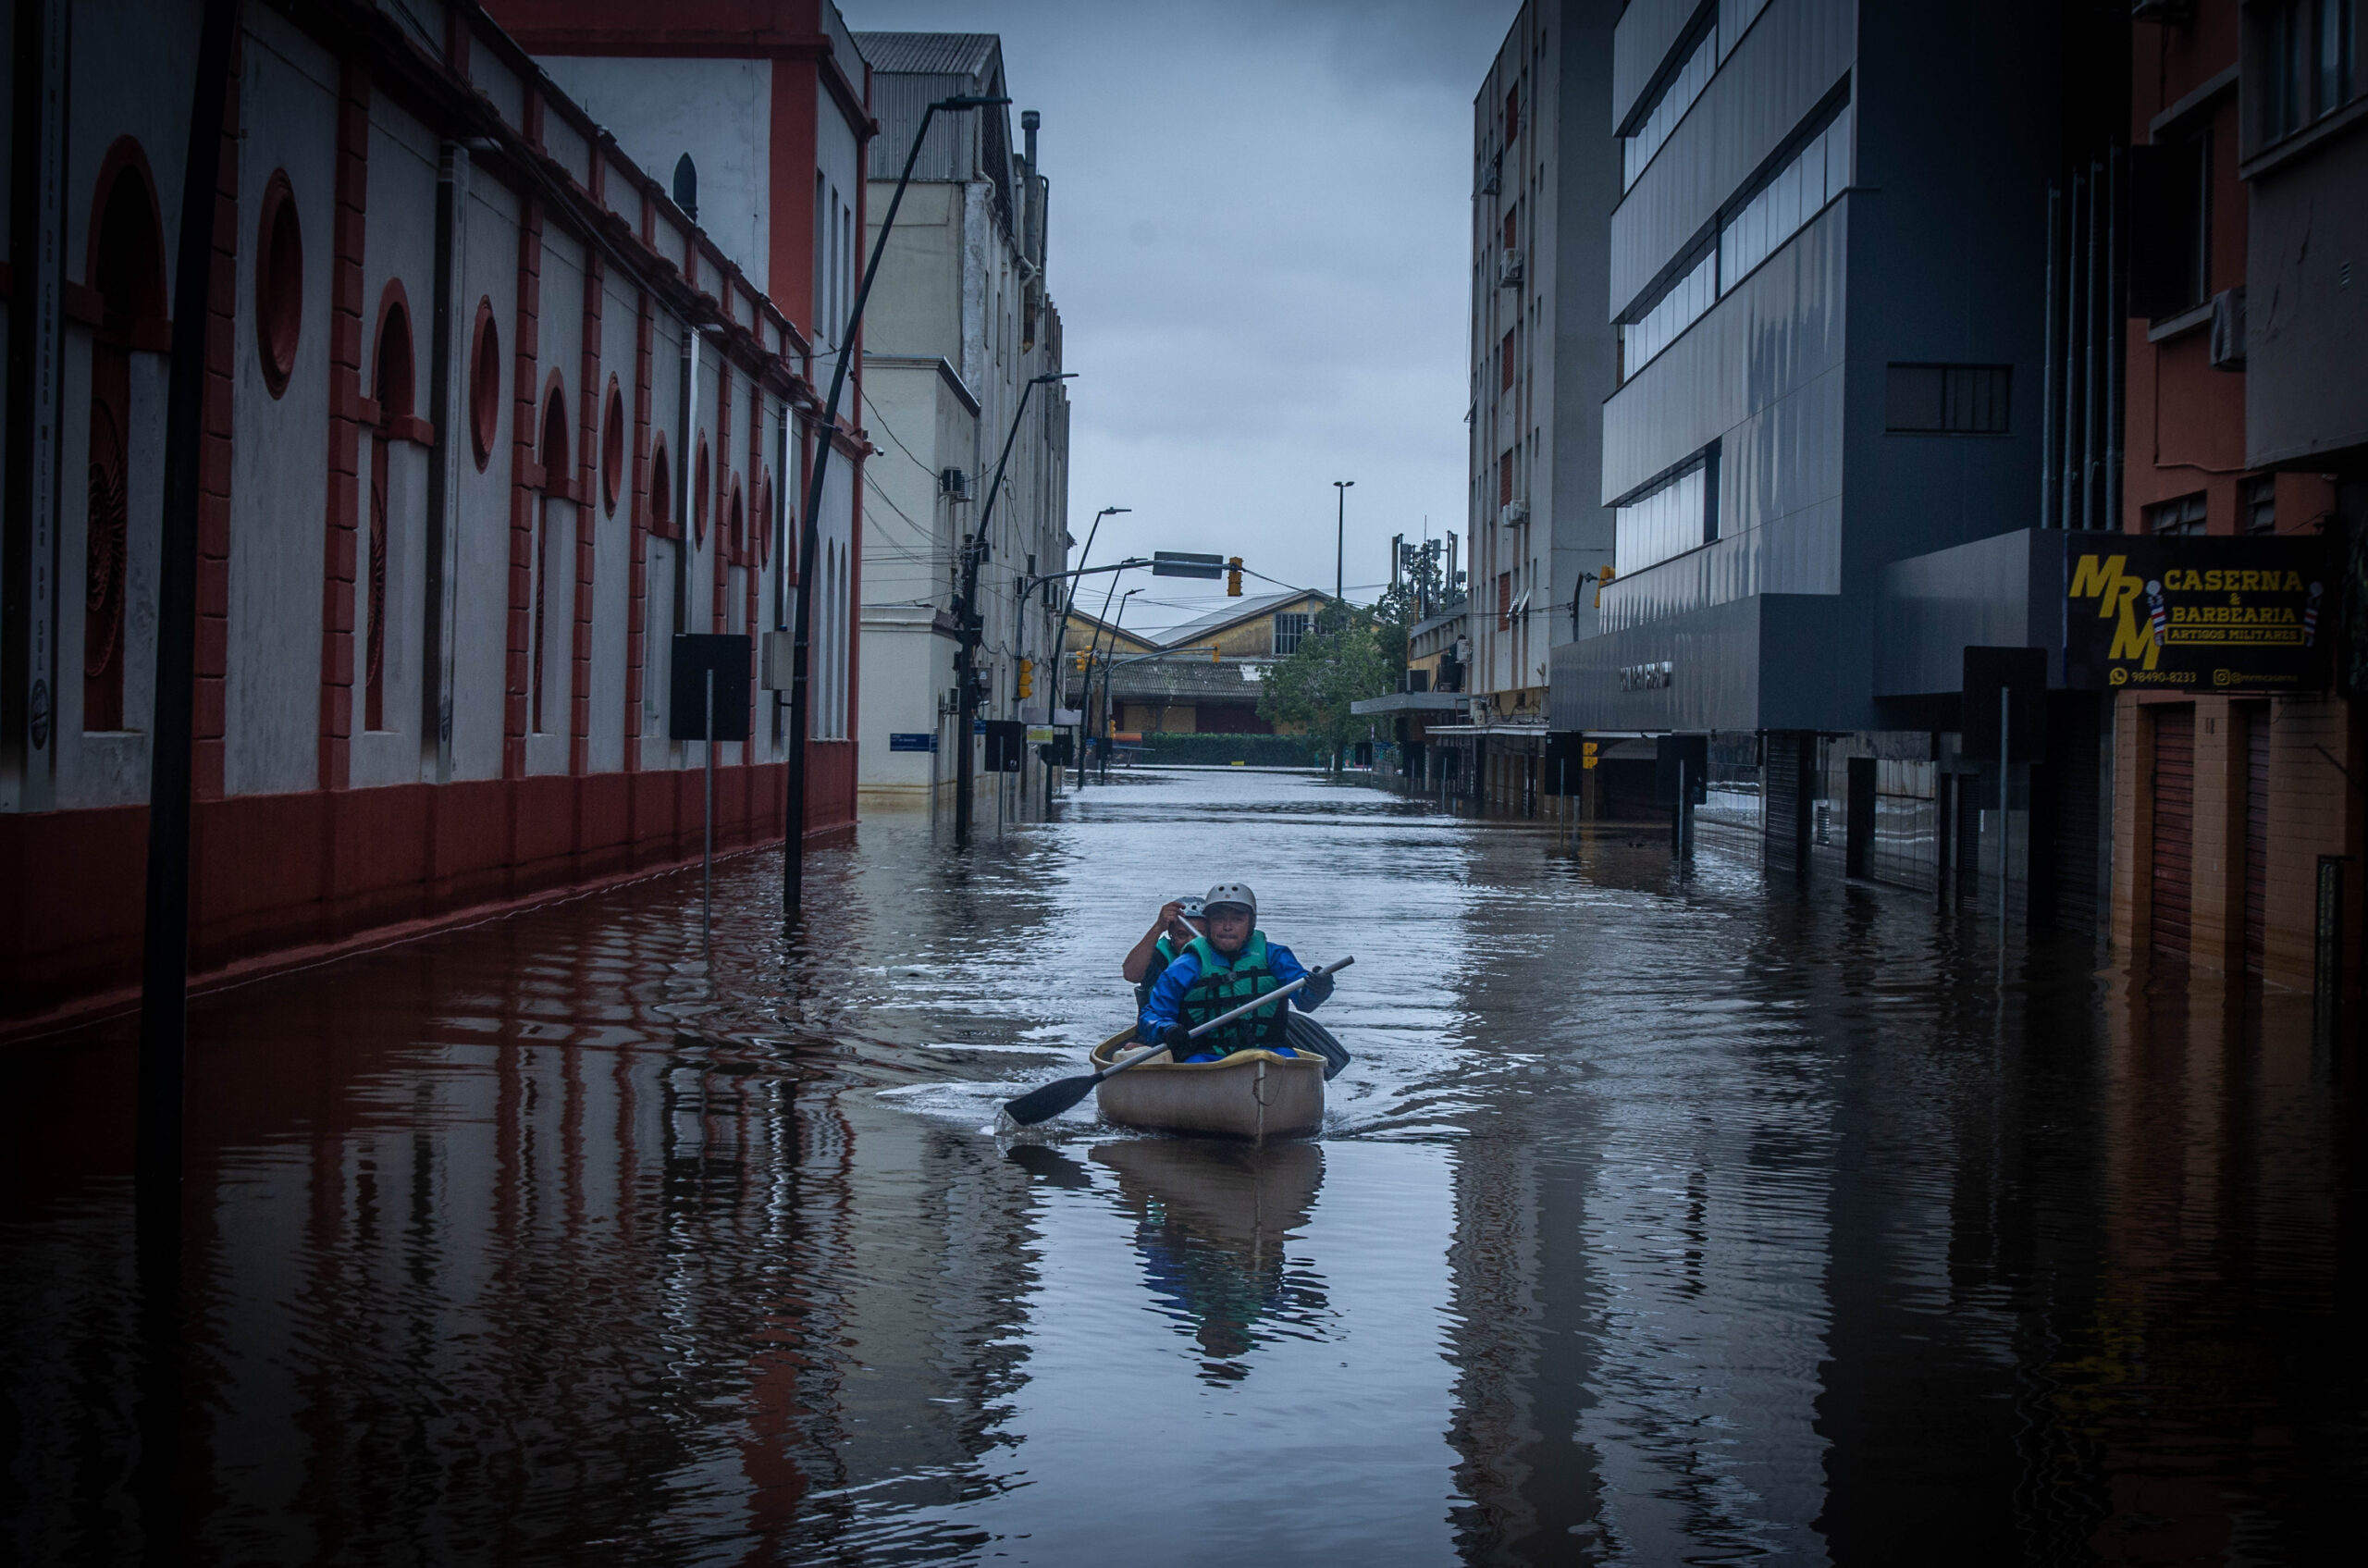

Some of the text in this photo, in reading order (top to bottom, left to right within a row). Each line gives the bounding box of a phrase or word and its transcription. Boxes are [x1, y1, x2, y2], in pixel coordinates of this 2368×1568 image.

[2164, 570, 2304, 592] CASERNA
[2229, 592, 2241, 606] &
[2068, 554, 2162, 670] MRM
[2171, 607, 2298, 623] BARBEARIA
[2170, 629, 2298, 640] ARTIGOS MILITARES
[2131, 672, 2197, 683] 98490-8233
